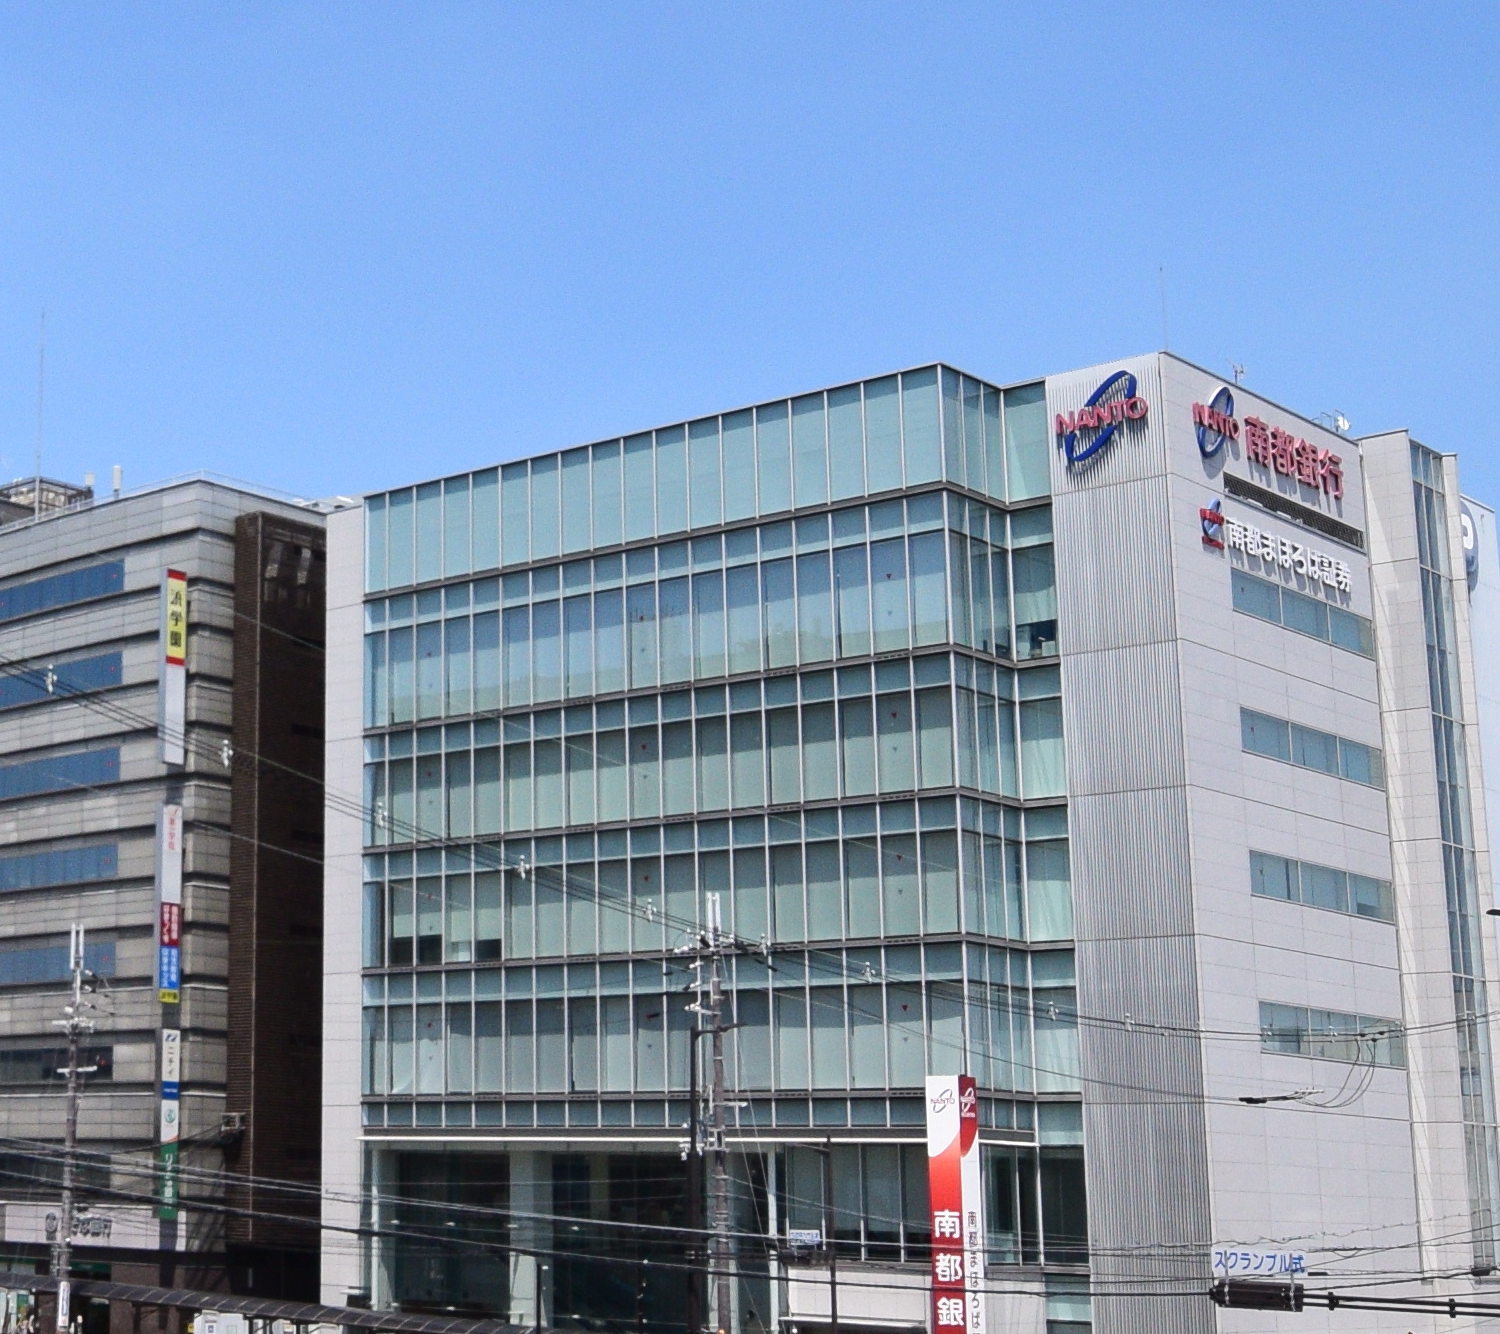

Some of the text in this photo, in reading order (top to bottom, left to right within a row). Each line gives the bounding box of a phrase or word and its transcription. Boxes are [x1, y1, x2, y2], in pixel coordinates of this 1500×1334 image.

[1055, 396, 1148, 436] NANTO
[1192, 401, 1240, 441] NANTO
[1244, 415, 1345, 500] 南都銀行
[1226, 517, 1352, 593] 南都まほろば証券
[1214, 1250, 1305, 1273] スクランブル式
